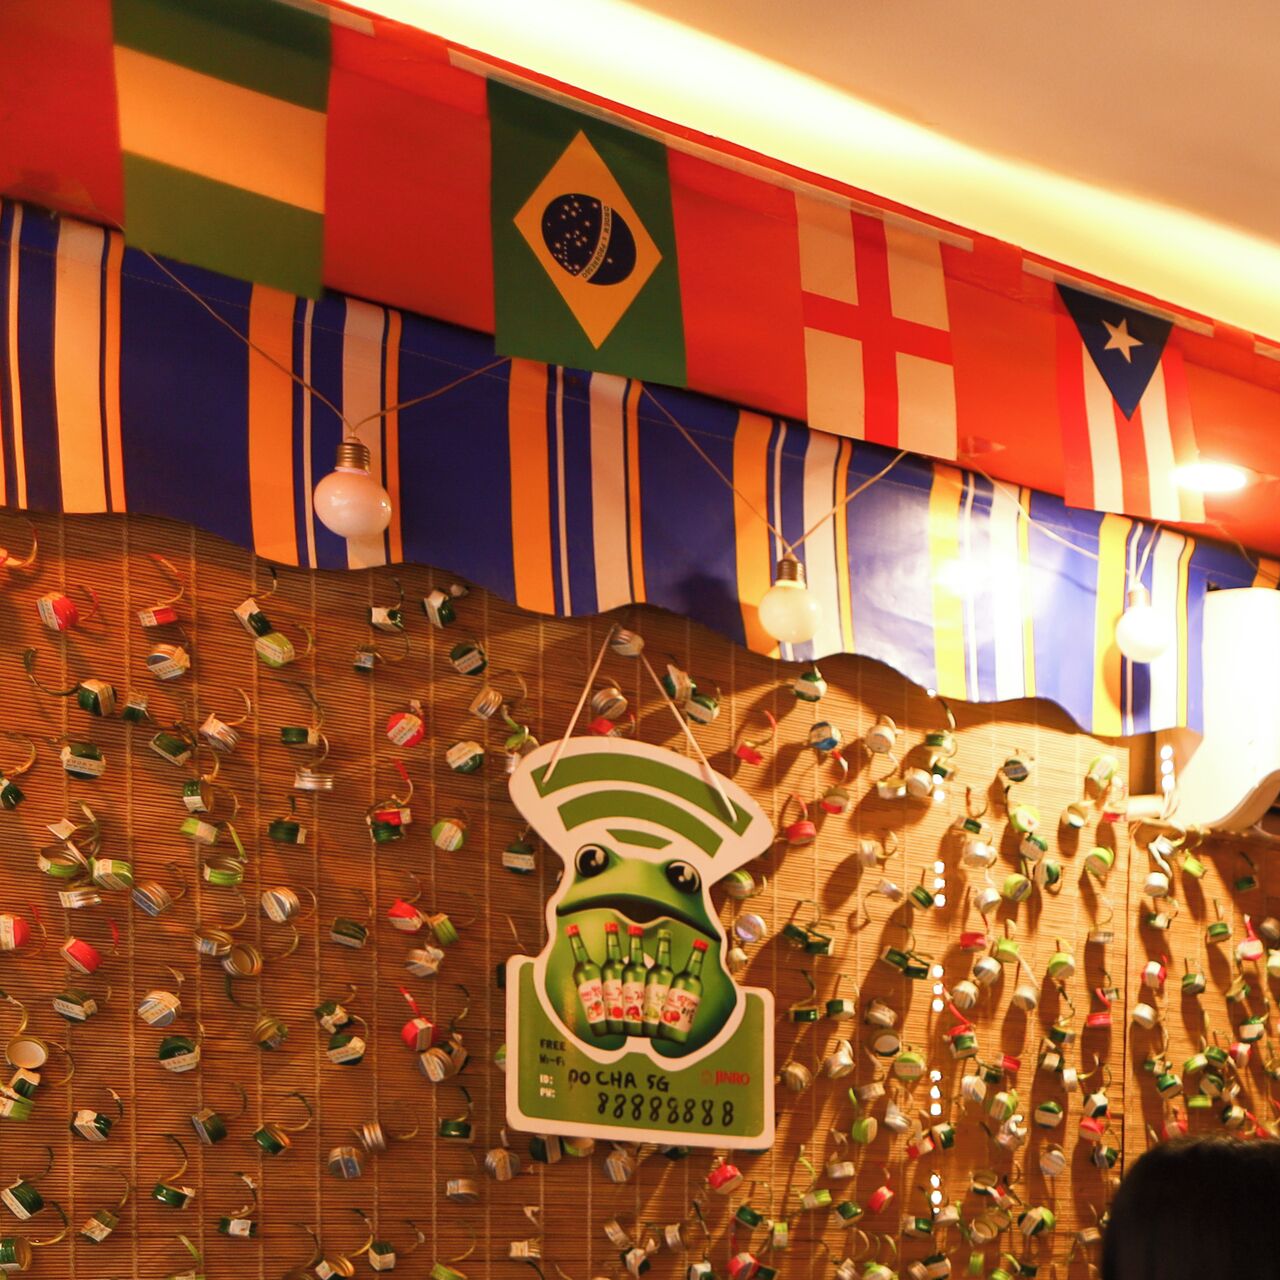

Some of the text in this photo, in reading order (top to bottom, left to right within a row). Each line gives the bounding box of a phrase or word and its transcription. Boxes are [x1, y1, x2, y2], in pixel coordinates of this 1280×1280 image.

[540, 1039, 566, 1051] FREE
[714, 1071, 751, 1087] JINRO
[598, 1092, 734, 1127] 88888888
